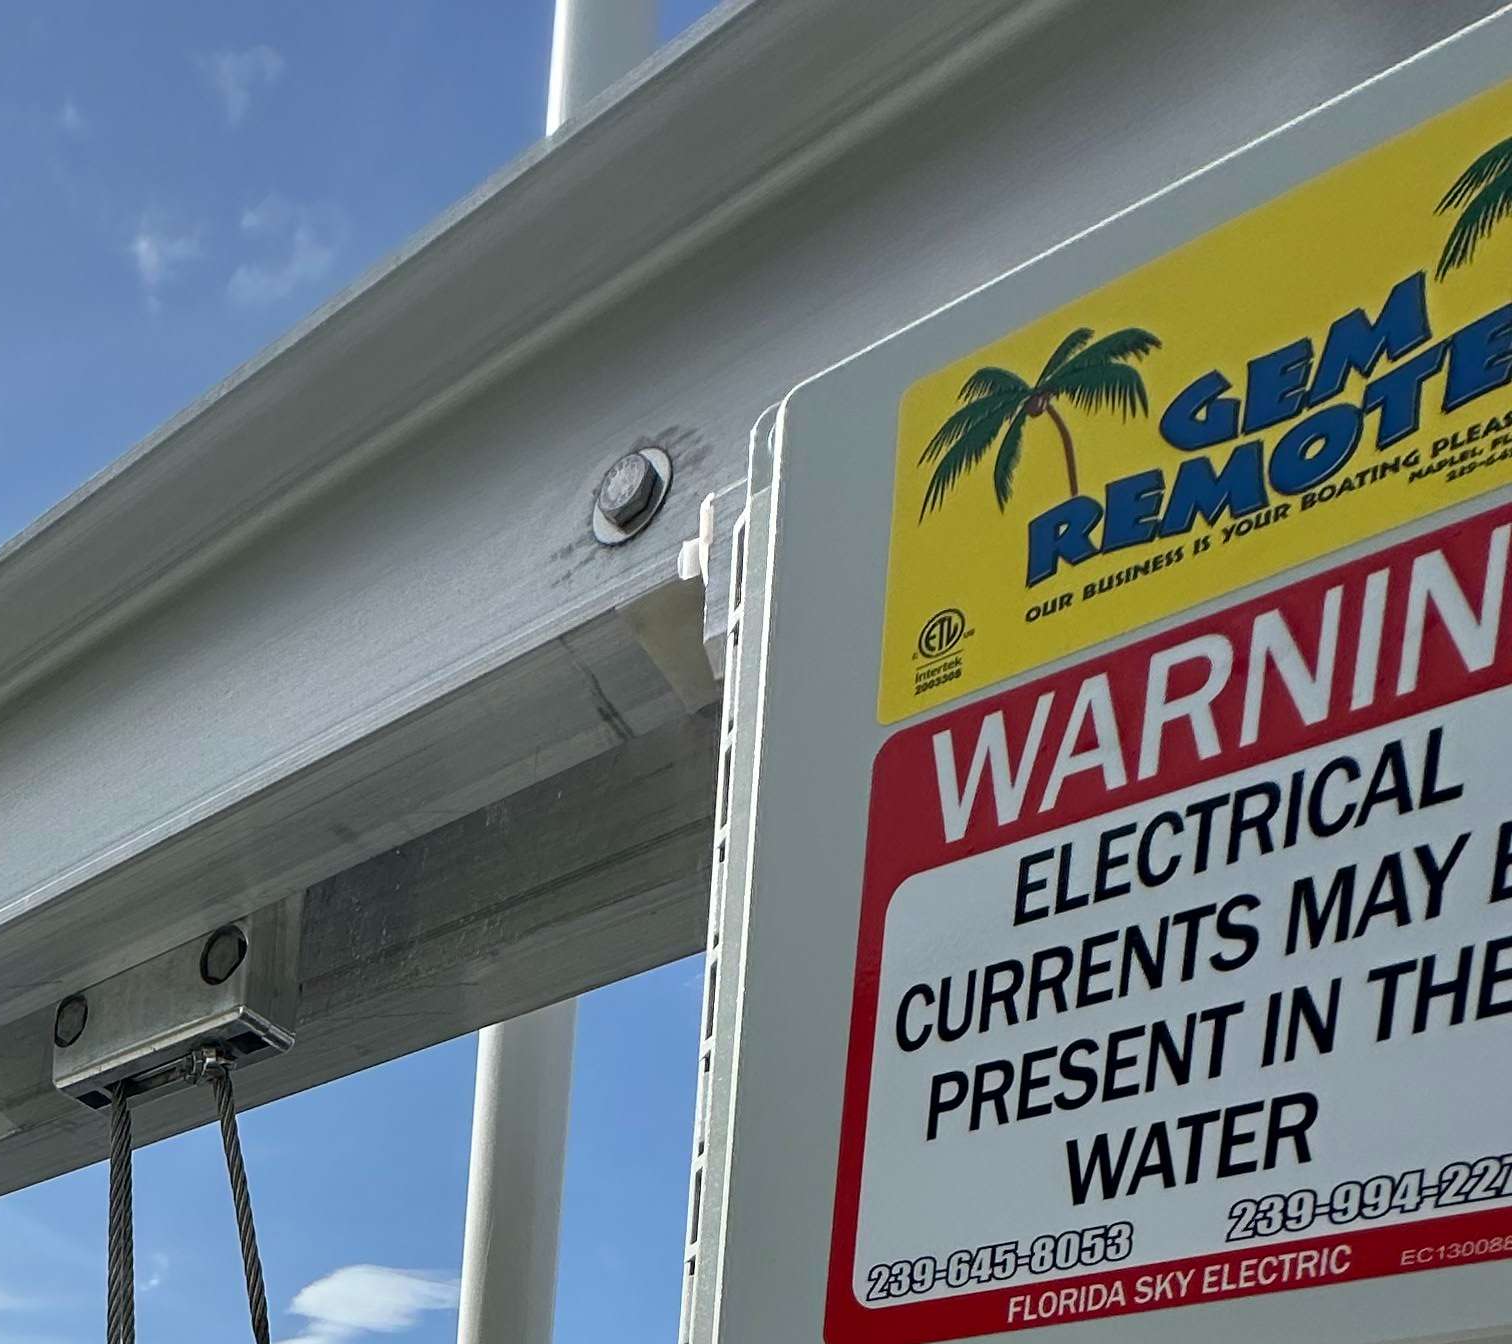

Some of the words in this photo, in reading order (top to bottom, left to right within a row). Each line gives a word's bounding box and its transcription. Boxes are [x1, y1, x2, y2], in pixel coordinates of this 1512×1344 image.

[1159, 270, 1432, 452] GEM
[1025, 592, 1074, 623] OUR
[1082, 546, 1184, 600] BUSINESS
[1193, 535, 1211, 555] IS
[1222, 503, 1290, 544] YOUR
[1300, 449, 1420, 512] BOATING
[915, 656, 963, 685] Intertek
[1013, 726, 1465, 927] ELECTRICAL
[895, 893, 1261, 1053] CURRENTS
[1285, 832, 1472, 957] MAY
[926, 1000, 1246, 1141] PRESENT
[1261, 977, 1342, 1068] IN
[1367, 937, 1512, 1043] THE
[1065, 1091, 1320, 1206] WATER
[865, 1220, 1134, 1301] 239-645-8053
[1006, 1280, 1128, 1323] FLORIDA
[1133, 1267, 1195, 1307] SKY
[1201, 1244, 1353, 1295] ELECTRIC
